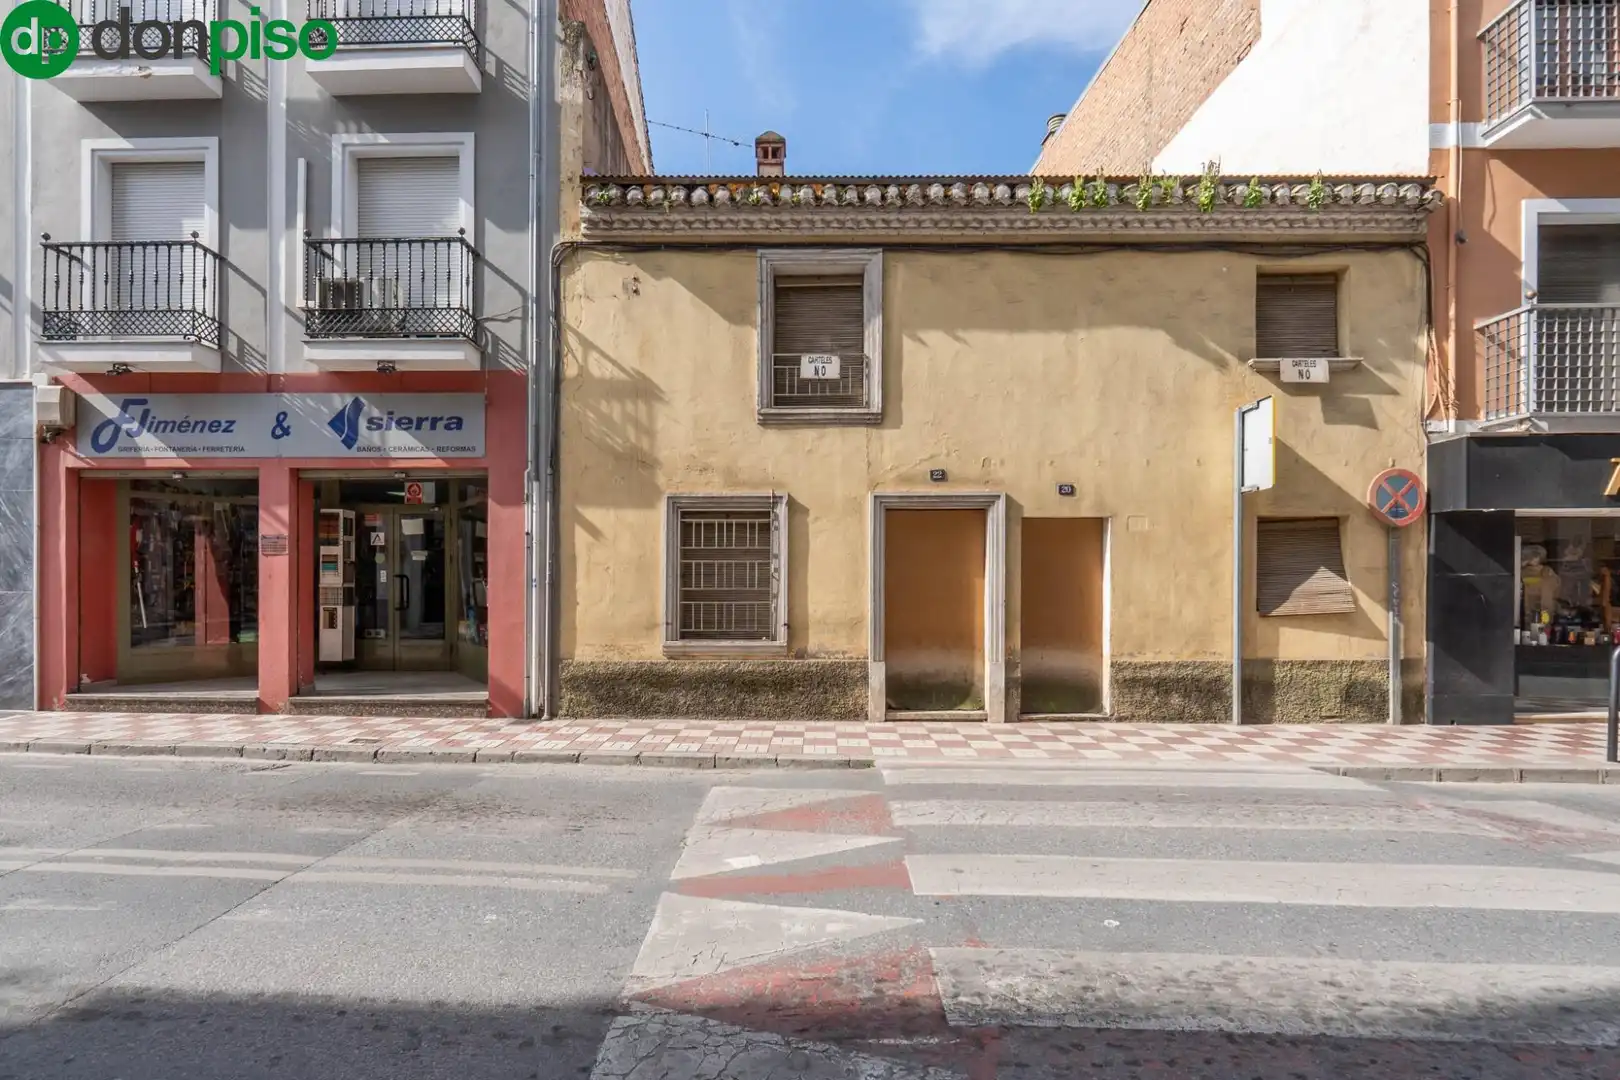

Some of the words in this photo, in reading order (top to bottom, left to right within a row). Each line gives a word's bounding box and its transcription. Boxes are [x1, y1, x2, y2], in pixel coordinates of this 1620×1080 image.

[807, 355, 833, 364] CARTELES
[1291, 359, 1317, 368] CARTELES
[814, 365, 827, 377] NO
[1298, 369, 1311, 380] NO
[271, 411, 291, 440] &
[365, 411, 464, 431] sierra
[436, 445, 476, 453] REFORMAS
